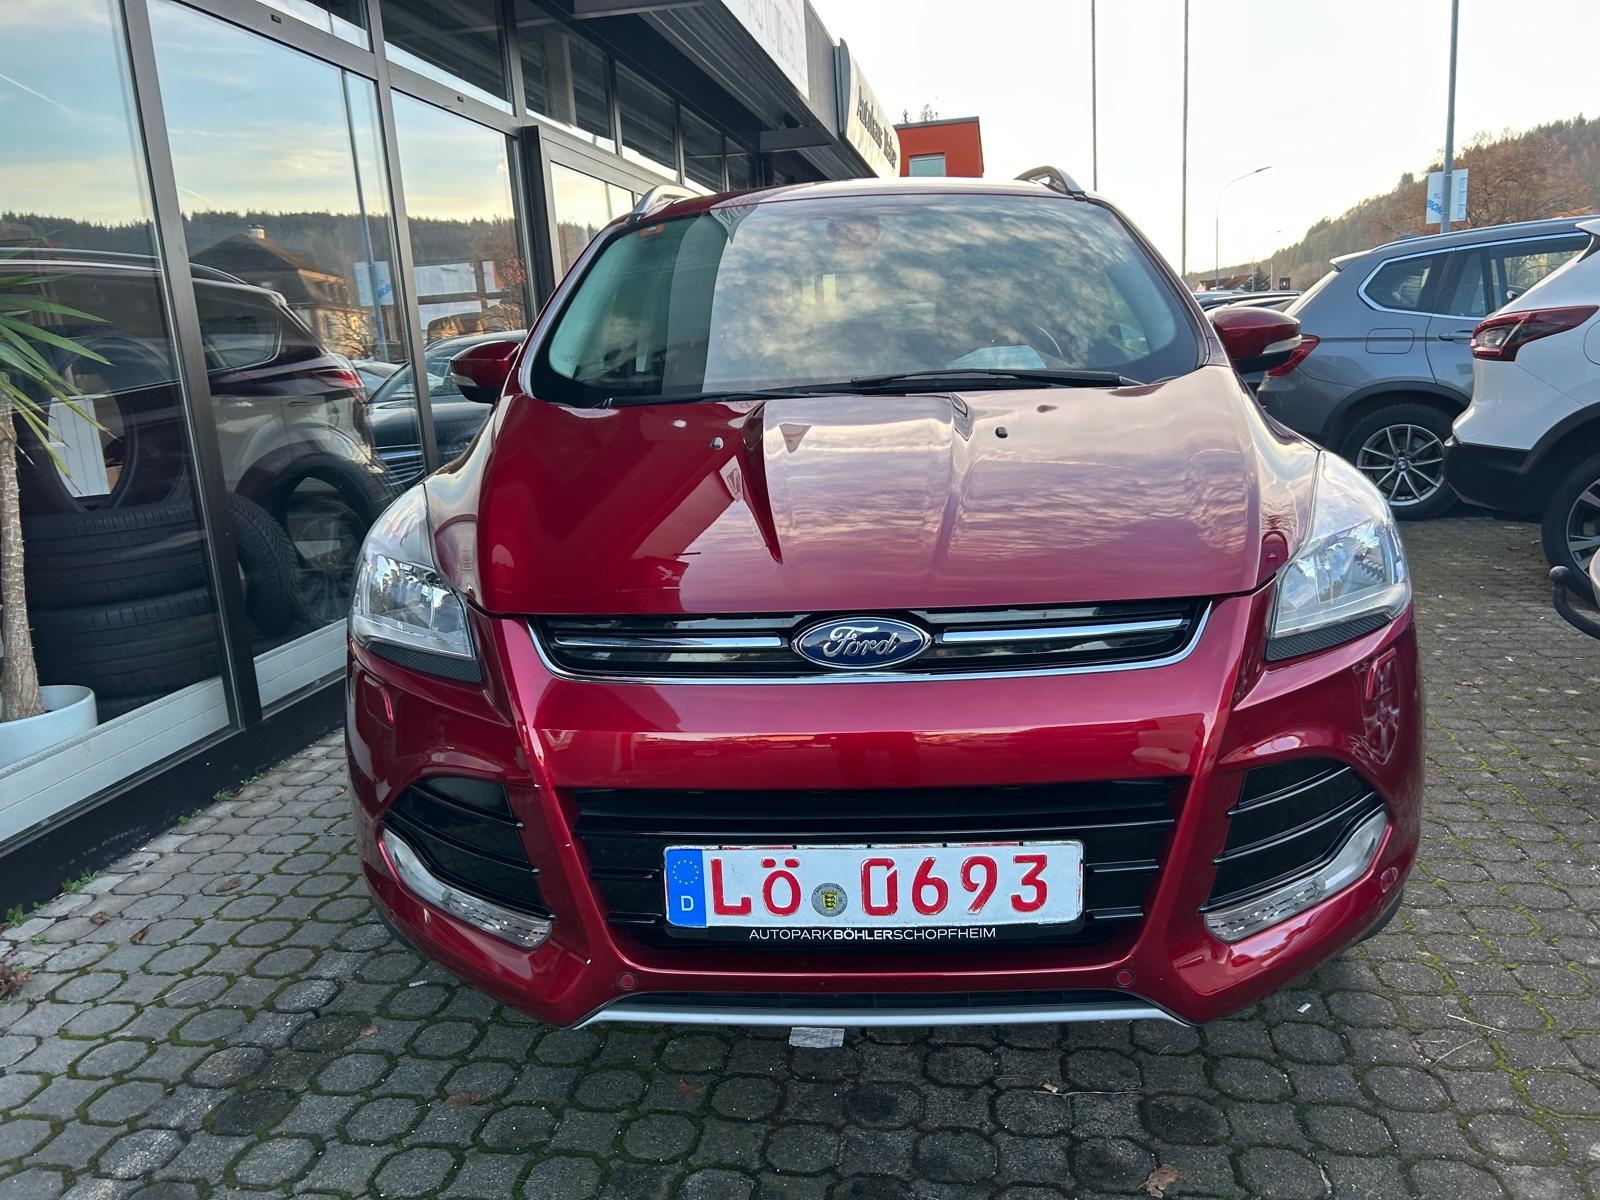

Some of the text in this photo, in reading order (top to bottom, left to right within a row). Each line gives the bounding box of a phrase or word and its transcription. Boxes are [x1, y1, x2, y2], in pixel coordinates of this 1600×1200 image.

[856, 85, 883, 149] Autohaus
[822, 625, 899, 658] Ford
[680, 895, 695, 912] D
[710, 857, 802, 917] LÖ
[860, 854, 1050, 917] 0693
